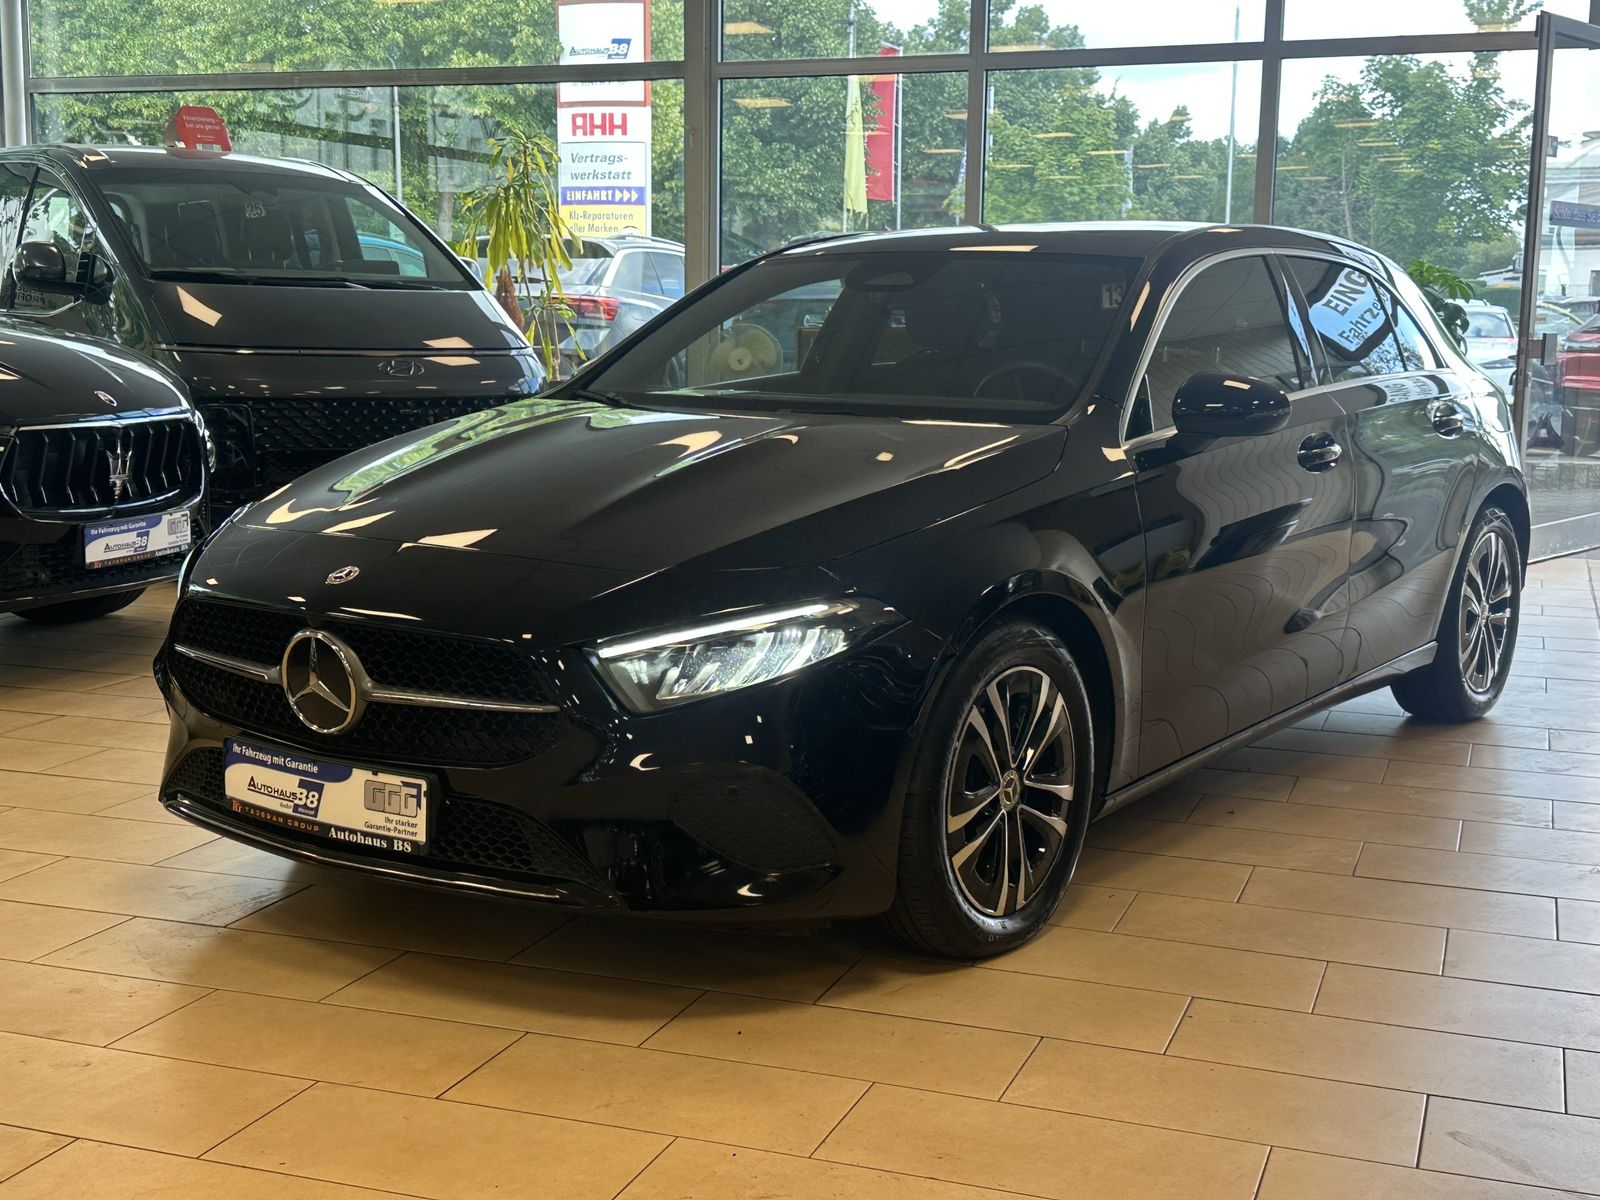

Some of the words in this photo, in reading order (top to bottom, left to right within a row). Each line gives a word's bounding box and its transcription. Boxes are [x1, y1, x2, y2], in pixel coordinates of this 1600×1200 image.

[571, 112, 628, 136] AHH
[570, 152, 628, 165] Vertrags-
[570, 169, 632, 180] werkstatt
[566, 189, 613, 201] EINFAHRT
[568, 210, 634, 221] Kfz-Reparaturen
[588, 223, 619, 233] Marken
[232, 743, 241, 754] Ihr
[241, 745, 272, 764] Fahrzeug
[272, 755, 285, 766] mit
[285, 757, 319, 774] Garantie
[287, 819, 320, 832] GROUP
[364, 821, 418, 837] Garantie-Partner
[384, 816, 393, 824] Ihr
[395, 819, 418, 829] starker
[328, 826, 388, 848] Autohaus
[393, 839, 412, 853] B8
